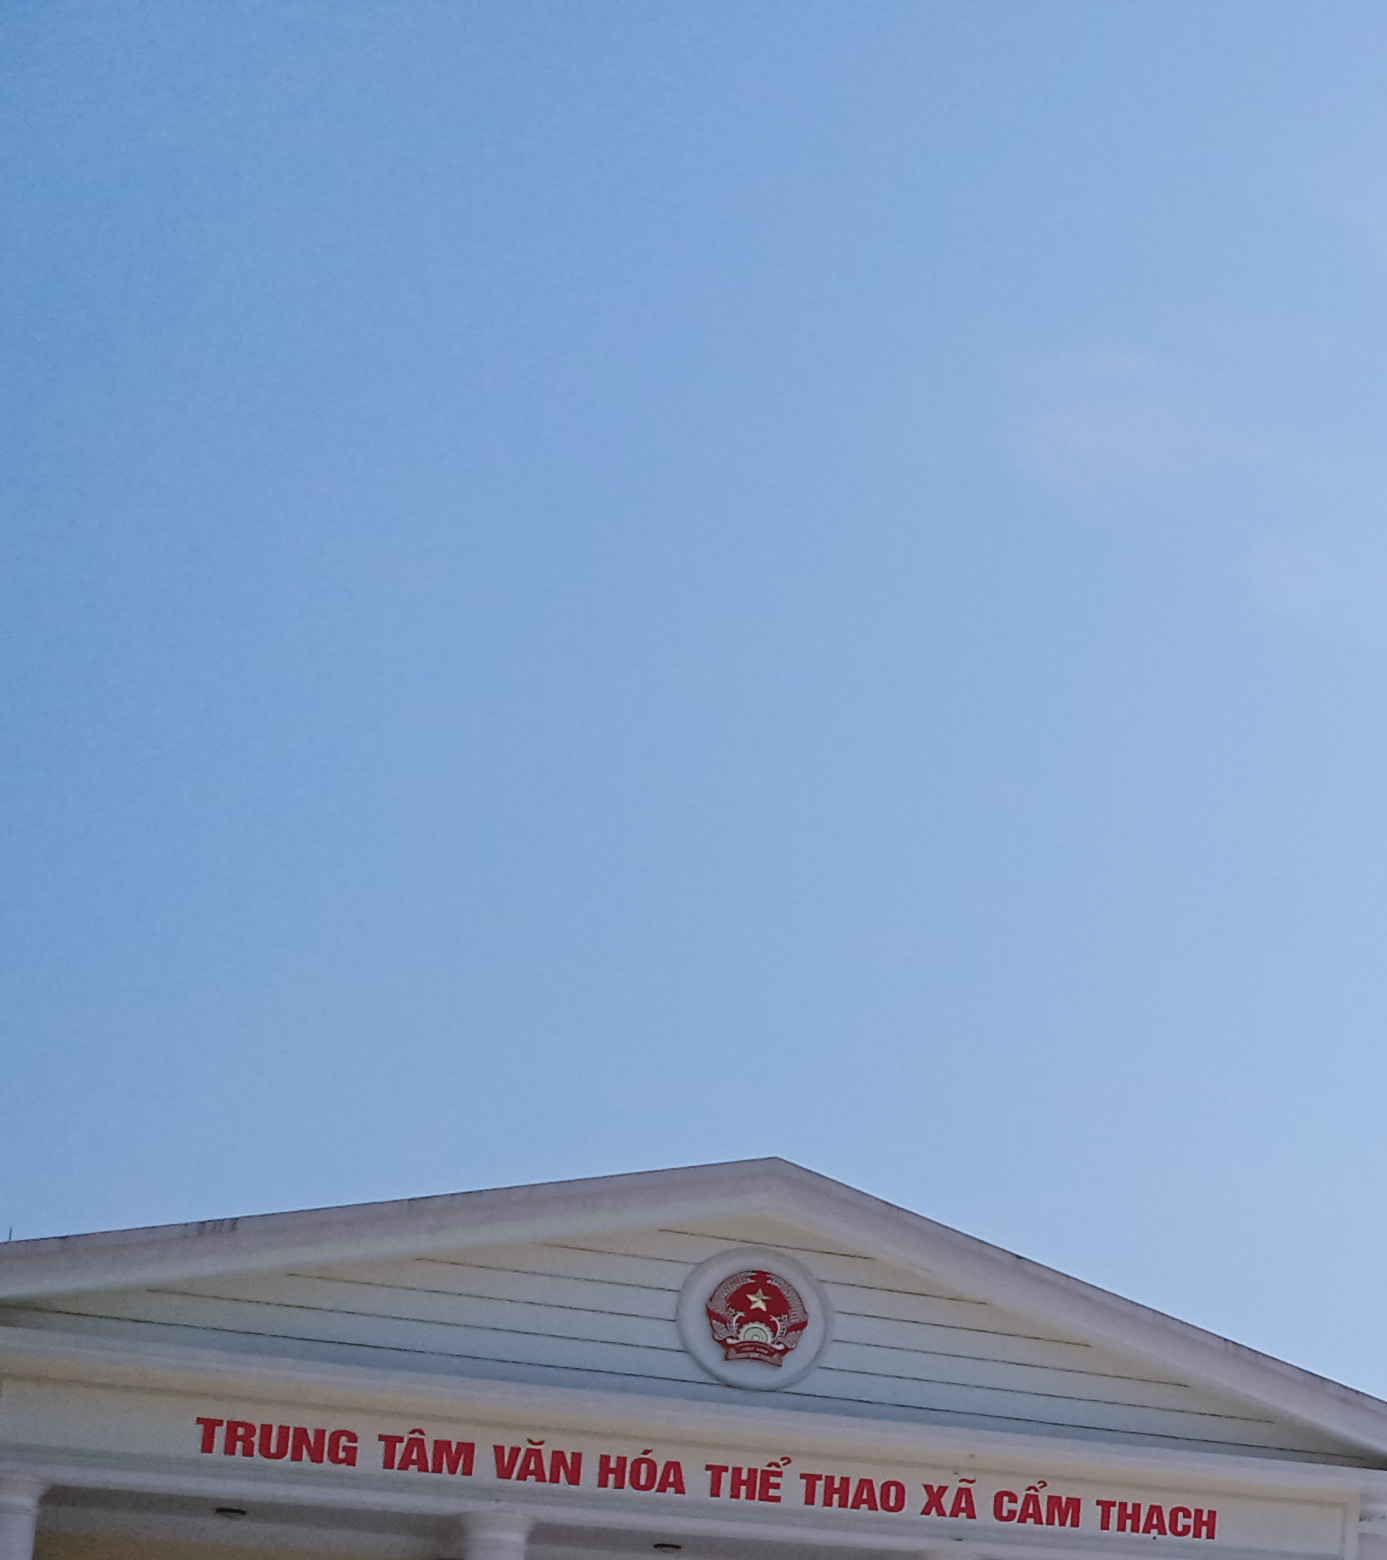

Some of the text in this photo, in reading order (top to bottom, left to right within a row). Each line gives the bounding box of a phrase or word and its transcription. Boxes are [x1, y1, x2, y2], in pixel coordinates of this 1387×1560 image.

[196, 1416, 1218, 1540] TRUNG TÂM VĂN HÓA THỂ THAO XÃ CẨM THẠCH
